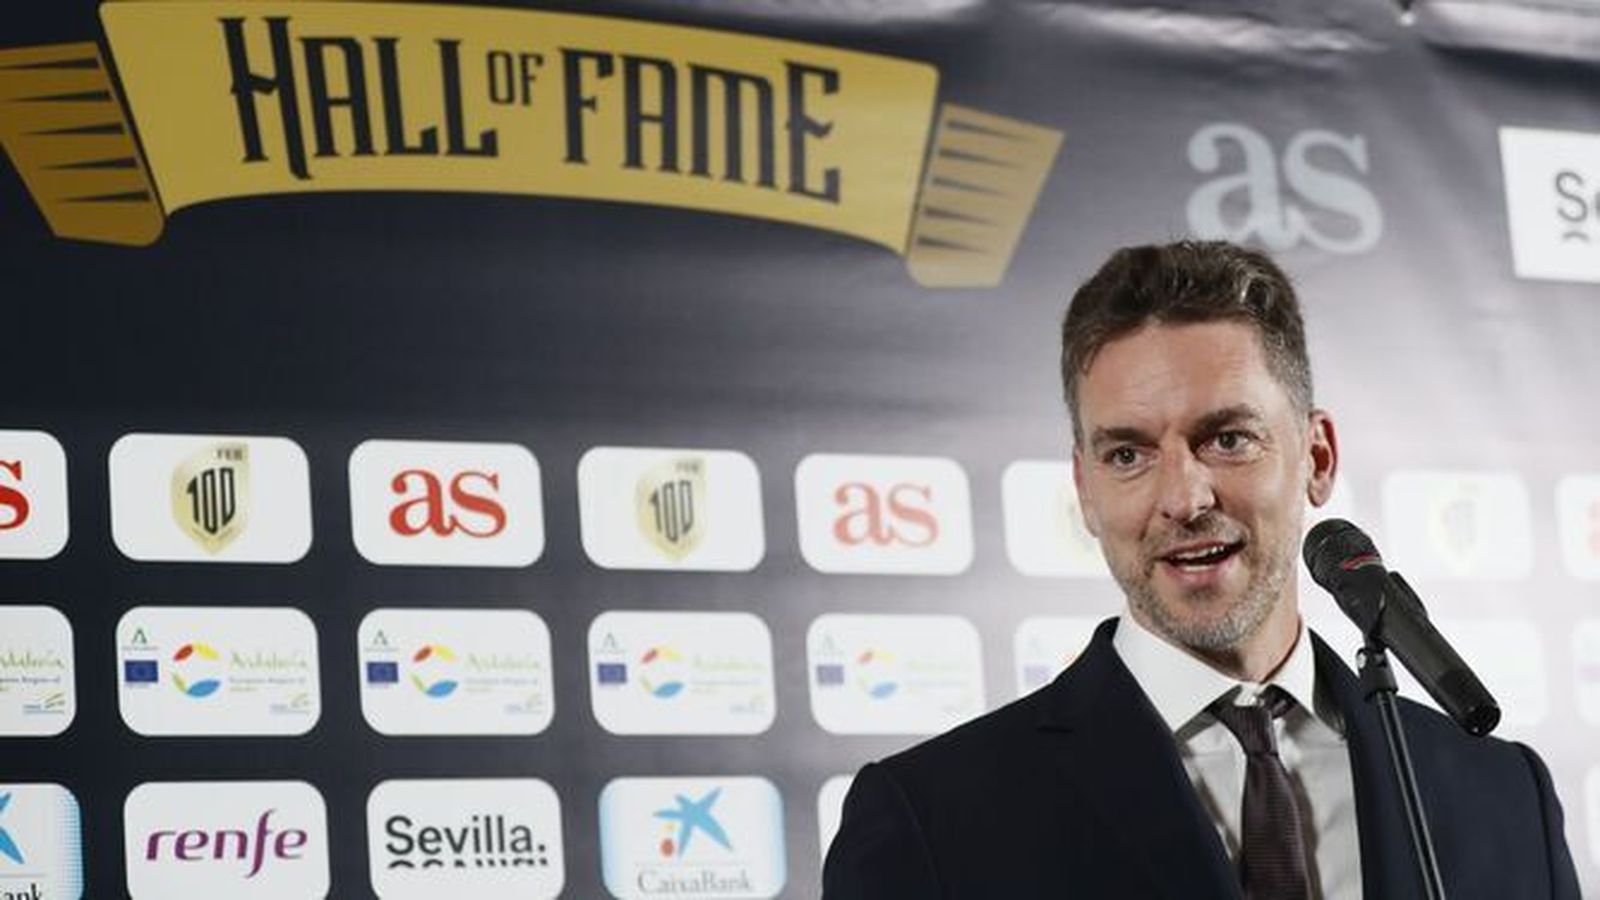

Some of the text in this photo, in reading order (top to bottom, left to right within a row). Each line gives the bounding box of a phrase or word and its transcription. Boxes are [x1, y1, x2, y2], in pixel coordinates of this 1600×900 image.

[219, 16, 841, 204] HALL OF FAME
[1186, 122, 1384, 255] as
[186, 467, 236, 534] 100
[388, 468, 508, 538] as
[832, 481, 940, 547] as
[146, 808, 308, 879] renfe
